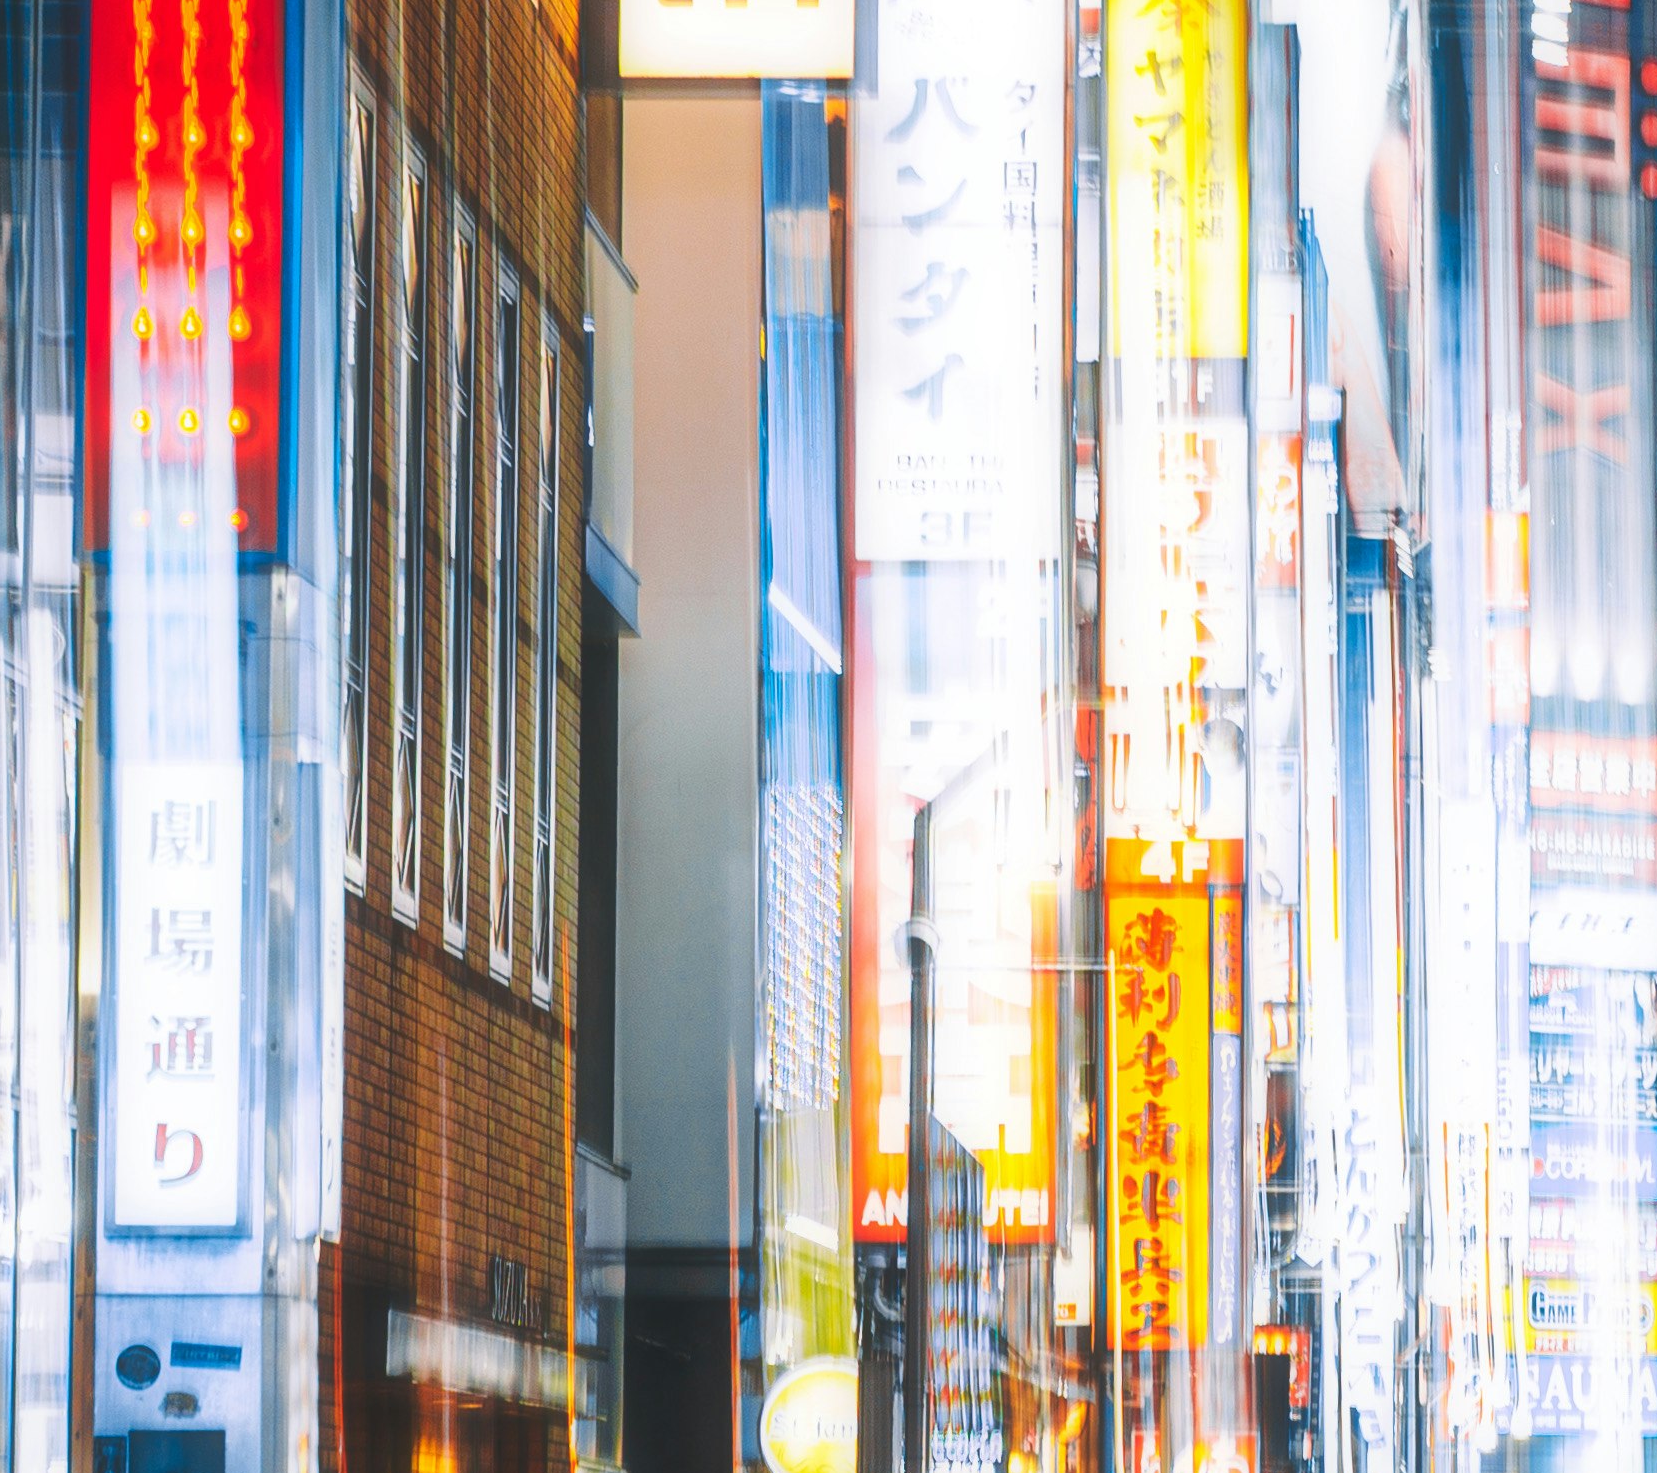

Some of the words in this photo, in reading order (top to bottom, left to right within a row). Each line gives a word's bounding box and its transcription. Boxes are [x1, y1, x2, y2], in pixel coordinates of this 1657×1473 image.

[884, 76, 983, 423] バンタイ
[1140, 839, 1211, 885] 4F
[146, 795, 218, 1189] 劇場通り
[861, 1188, 1050, 1227] ANUTEI
